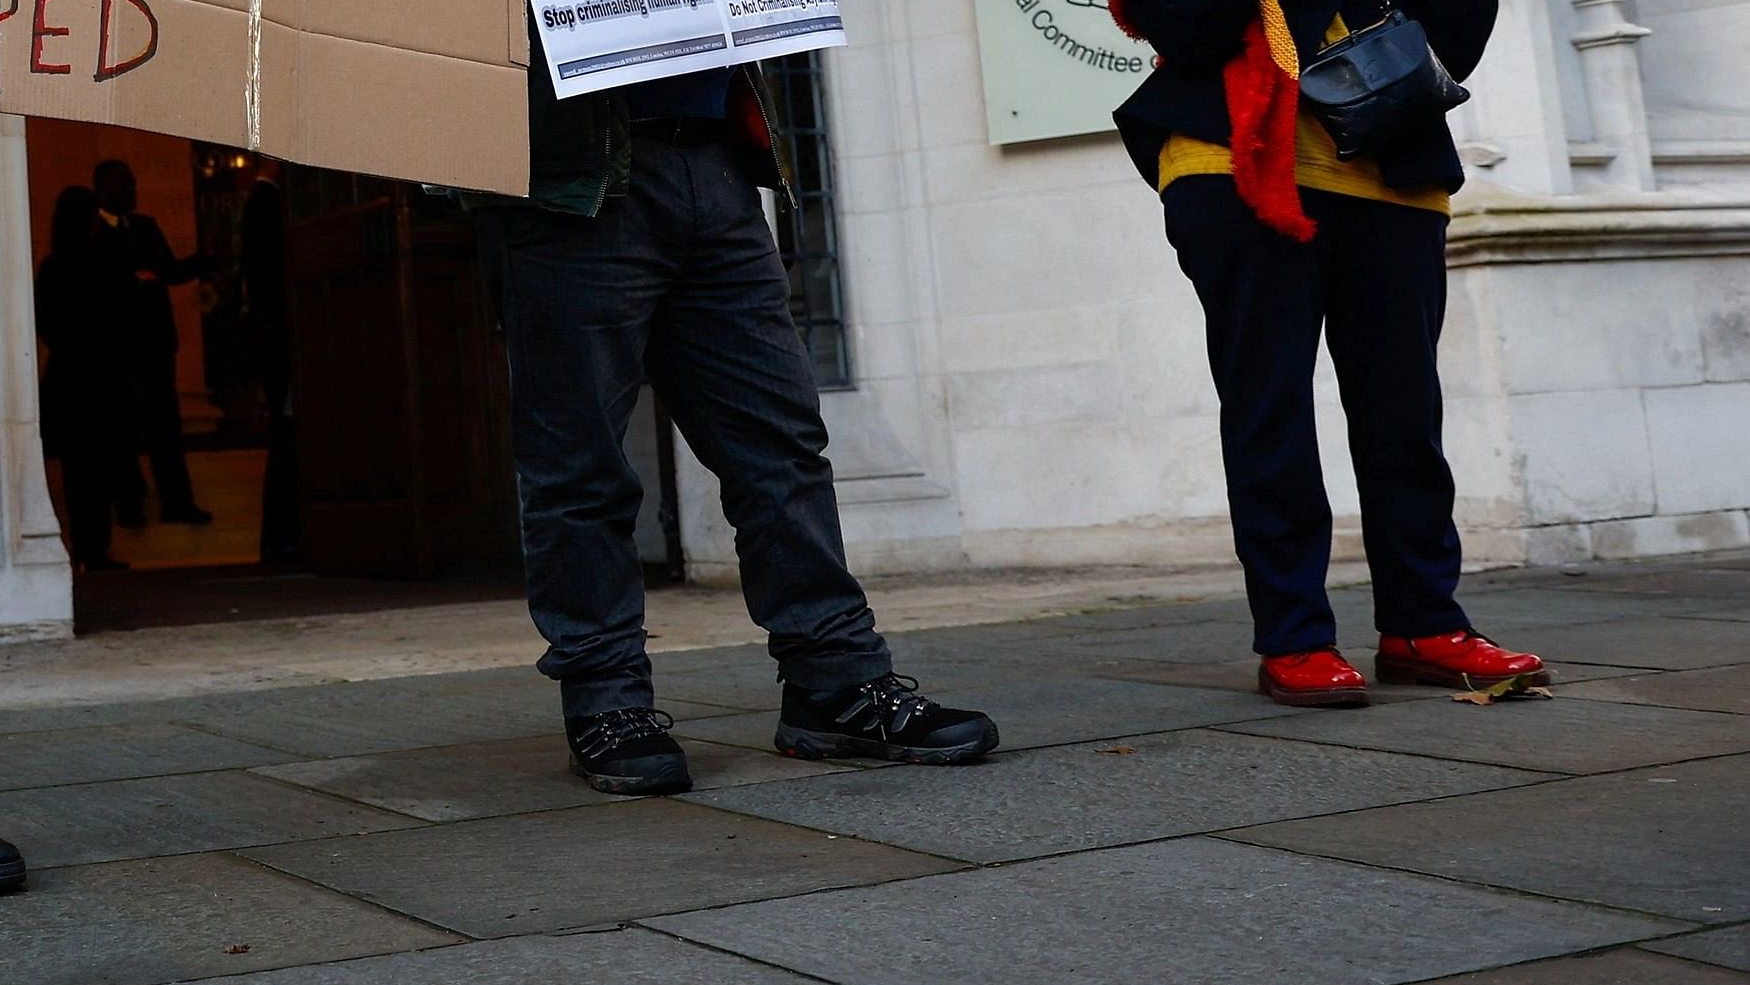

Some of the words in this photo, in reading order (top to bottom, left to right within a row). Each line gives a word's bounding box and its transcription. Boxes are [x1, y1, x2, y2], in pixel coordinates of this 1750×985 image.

[543, 7, 576, 28] Stop
[729, 2, 742, 16] Do
[741, 0, 758, 15] Not
[1032, 9, 1143, 73] Committee
